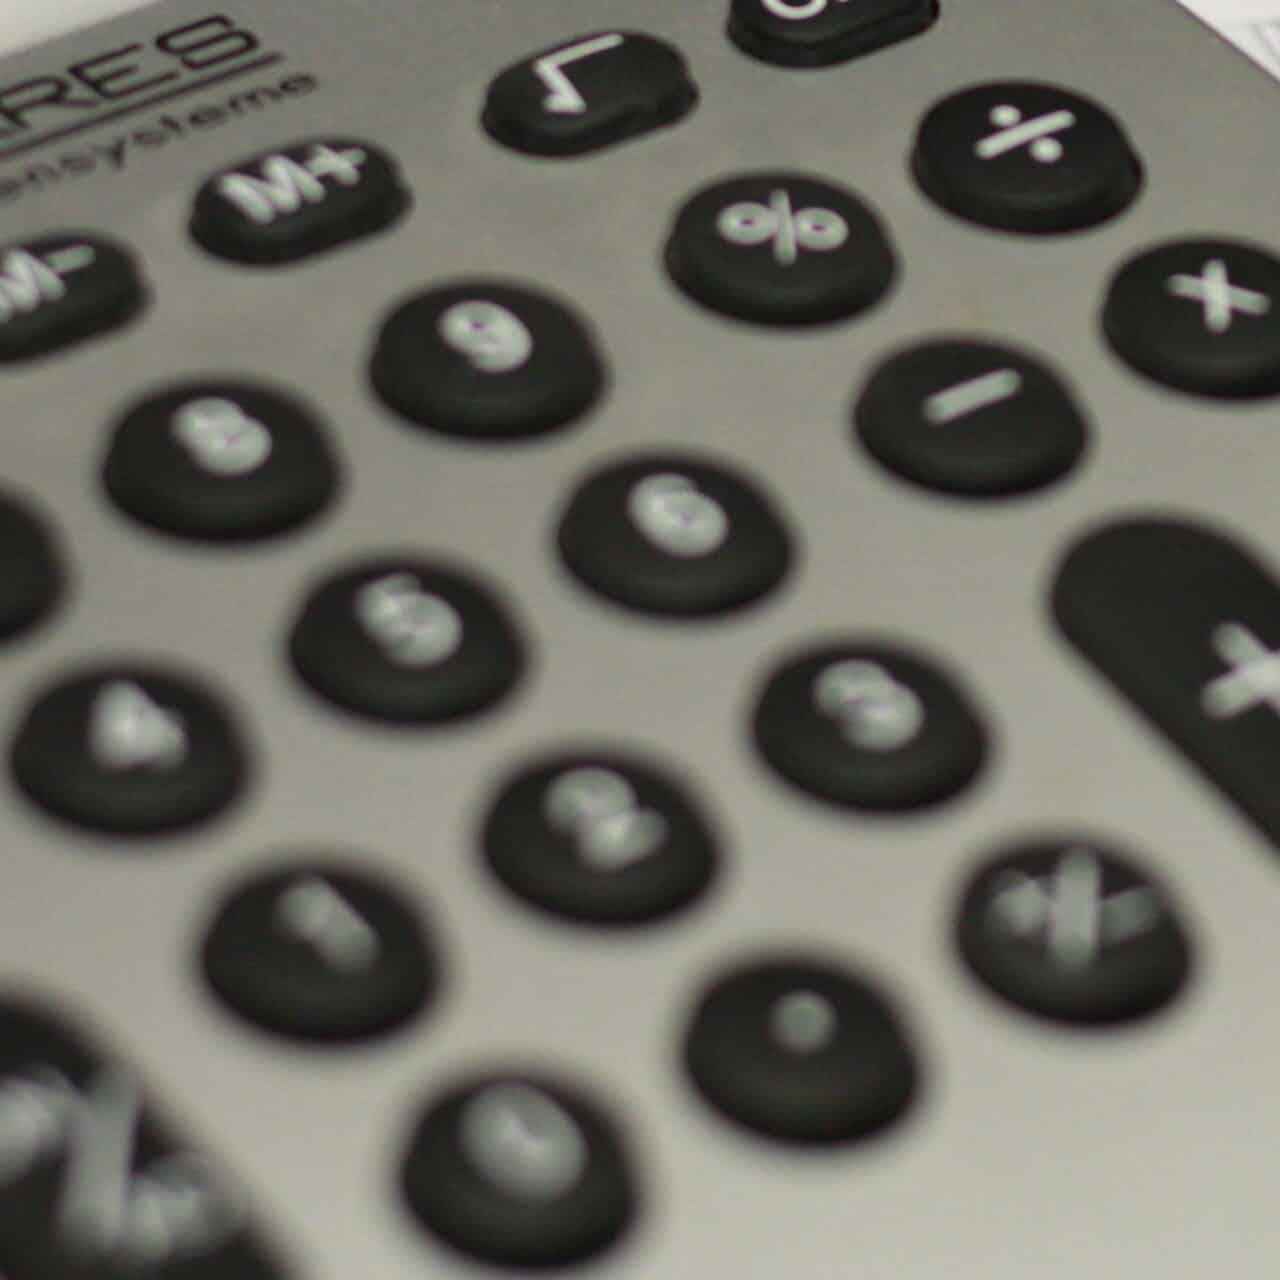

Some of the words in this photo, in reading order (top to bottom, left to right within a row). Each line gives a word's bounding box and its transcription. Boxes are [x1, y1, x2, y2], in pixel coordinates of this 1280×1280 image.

[0, 14, 259, 141] RES
[220, 143, 365, 223] M+
[716, 190, 849, 262] %
[441, 300, 532, 372] 9
[175, 397, 272, 474] 8
[630, 474, 727, 556] 6
[92, 681, 187, 766] 4
[816, 660, 923, 750] 3
